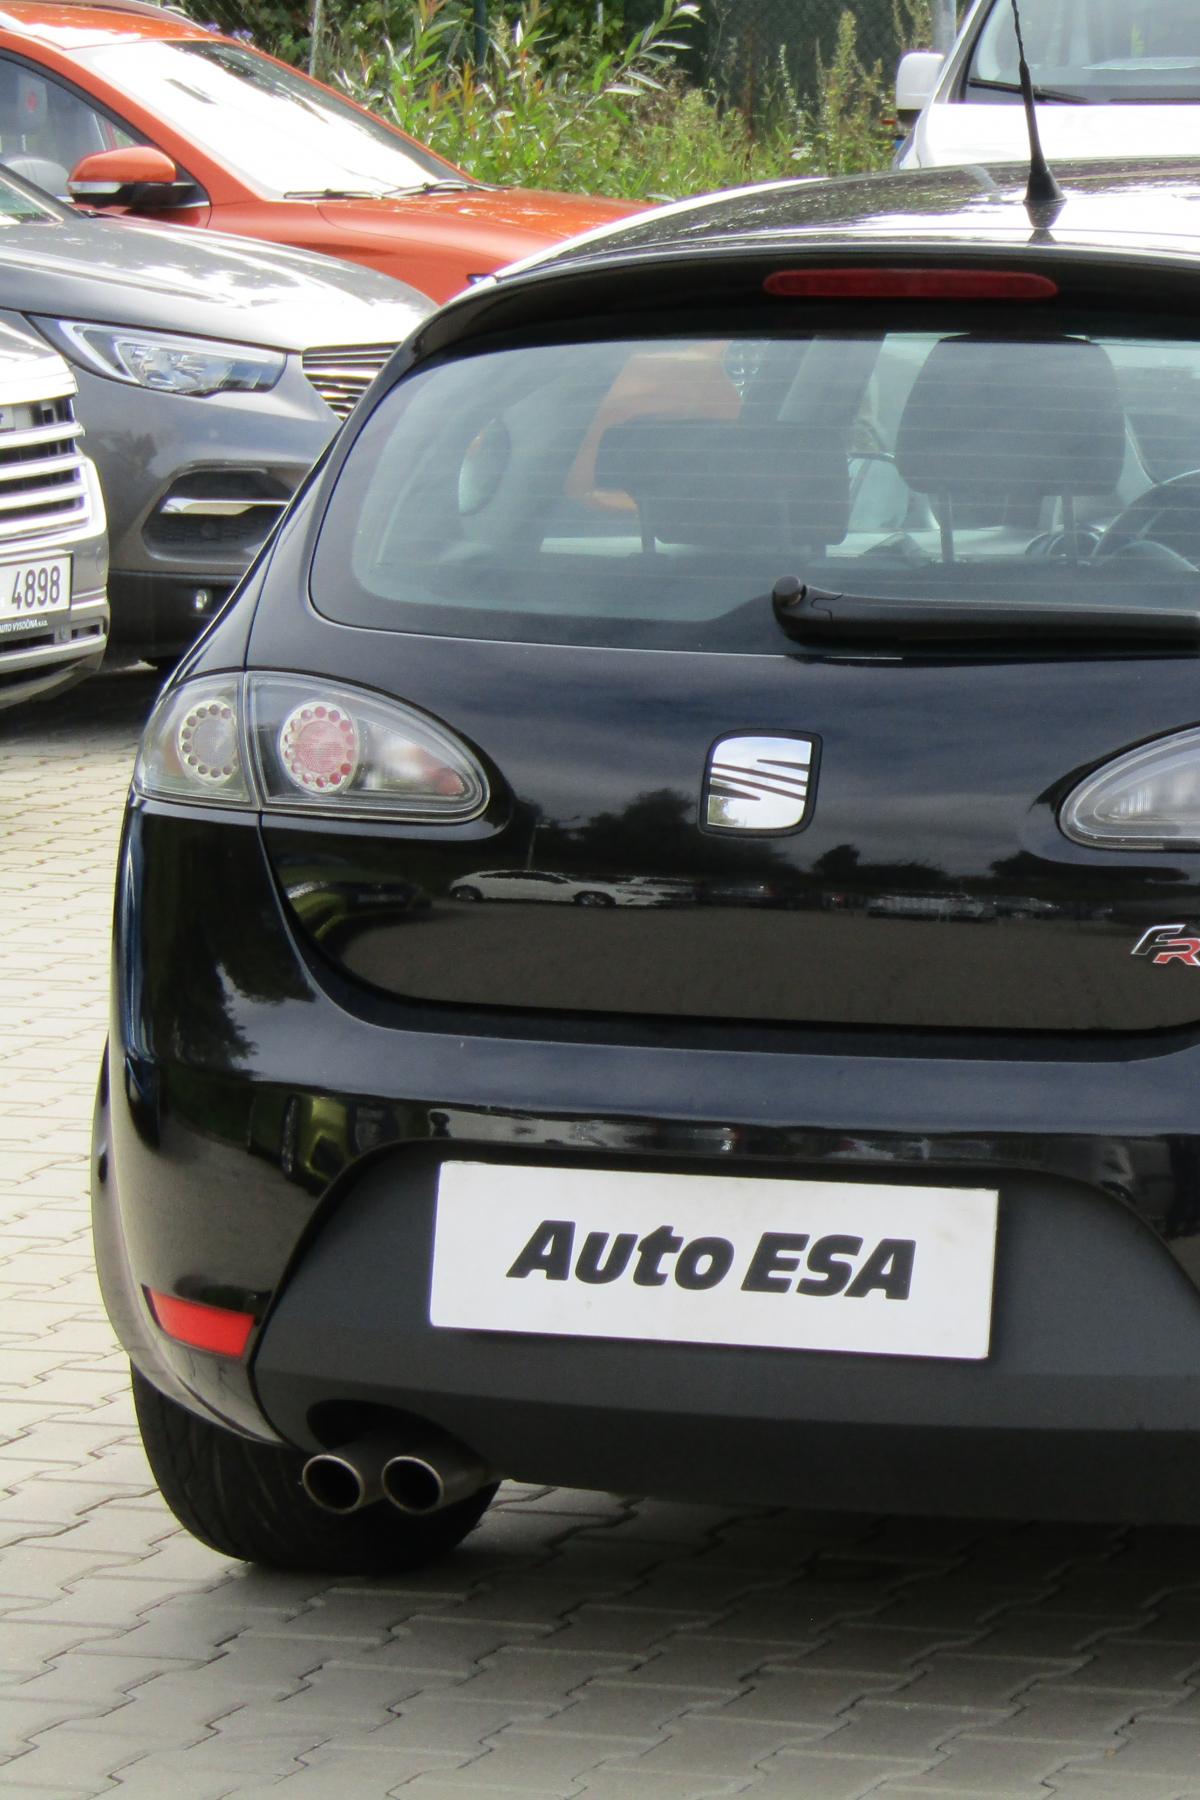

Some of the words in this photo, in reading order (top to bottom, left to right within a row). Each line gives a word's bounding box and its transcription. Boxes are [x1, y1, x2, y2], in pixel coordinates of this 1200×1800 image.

[11, 565, 61, 610] 4898
[506, 1219, 734, 1291] Auto
[741, 1231, 917, 1301] ESA
